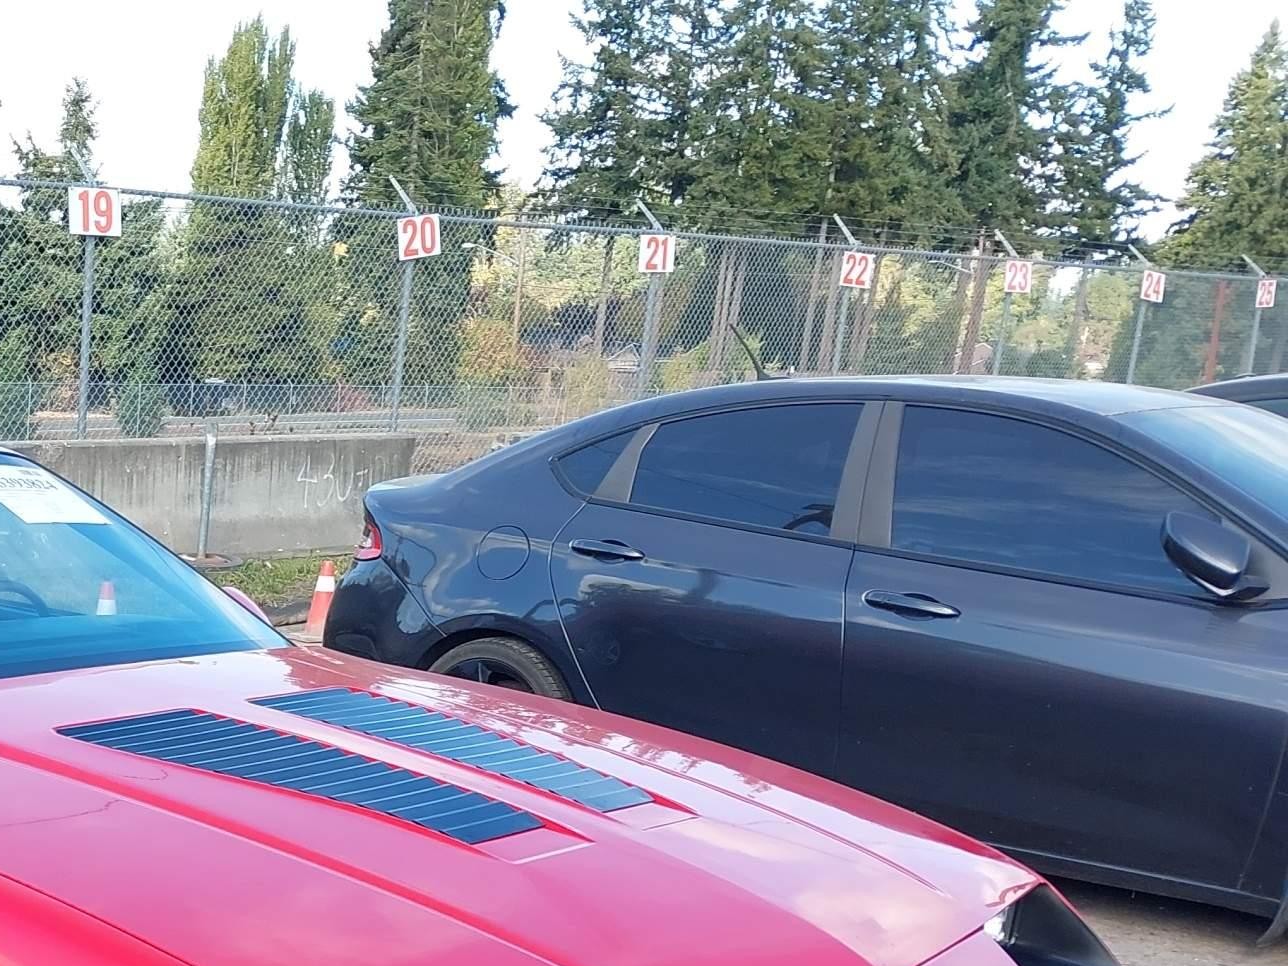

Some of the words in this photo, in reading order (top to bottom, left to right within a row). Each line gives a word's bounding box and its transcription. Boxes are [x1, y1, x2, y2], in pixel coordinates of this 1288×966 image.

[79, 190, 113, 233] 19
[402, 216, 437, 258] 20
[645, 236, 668, 271] 21
[842, 253, 870, 286] 22
[1007, 262, 1029, 291] 23
[1143, 273, 1163, 300] 24
[1258, 282, 1274, 306] 25
